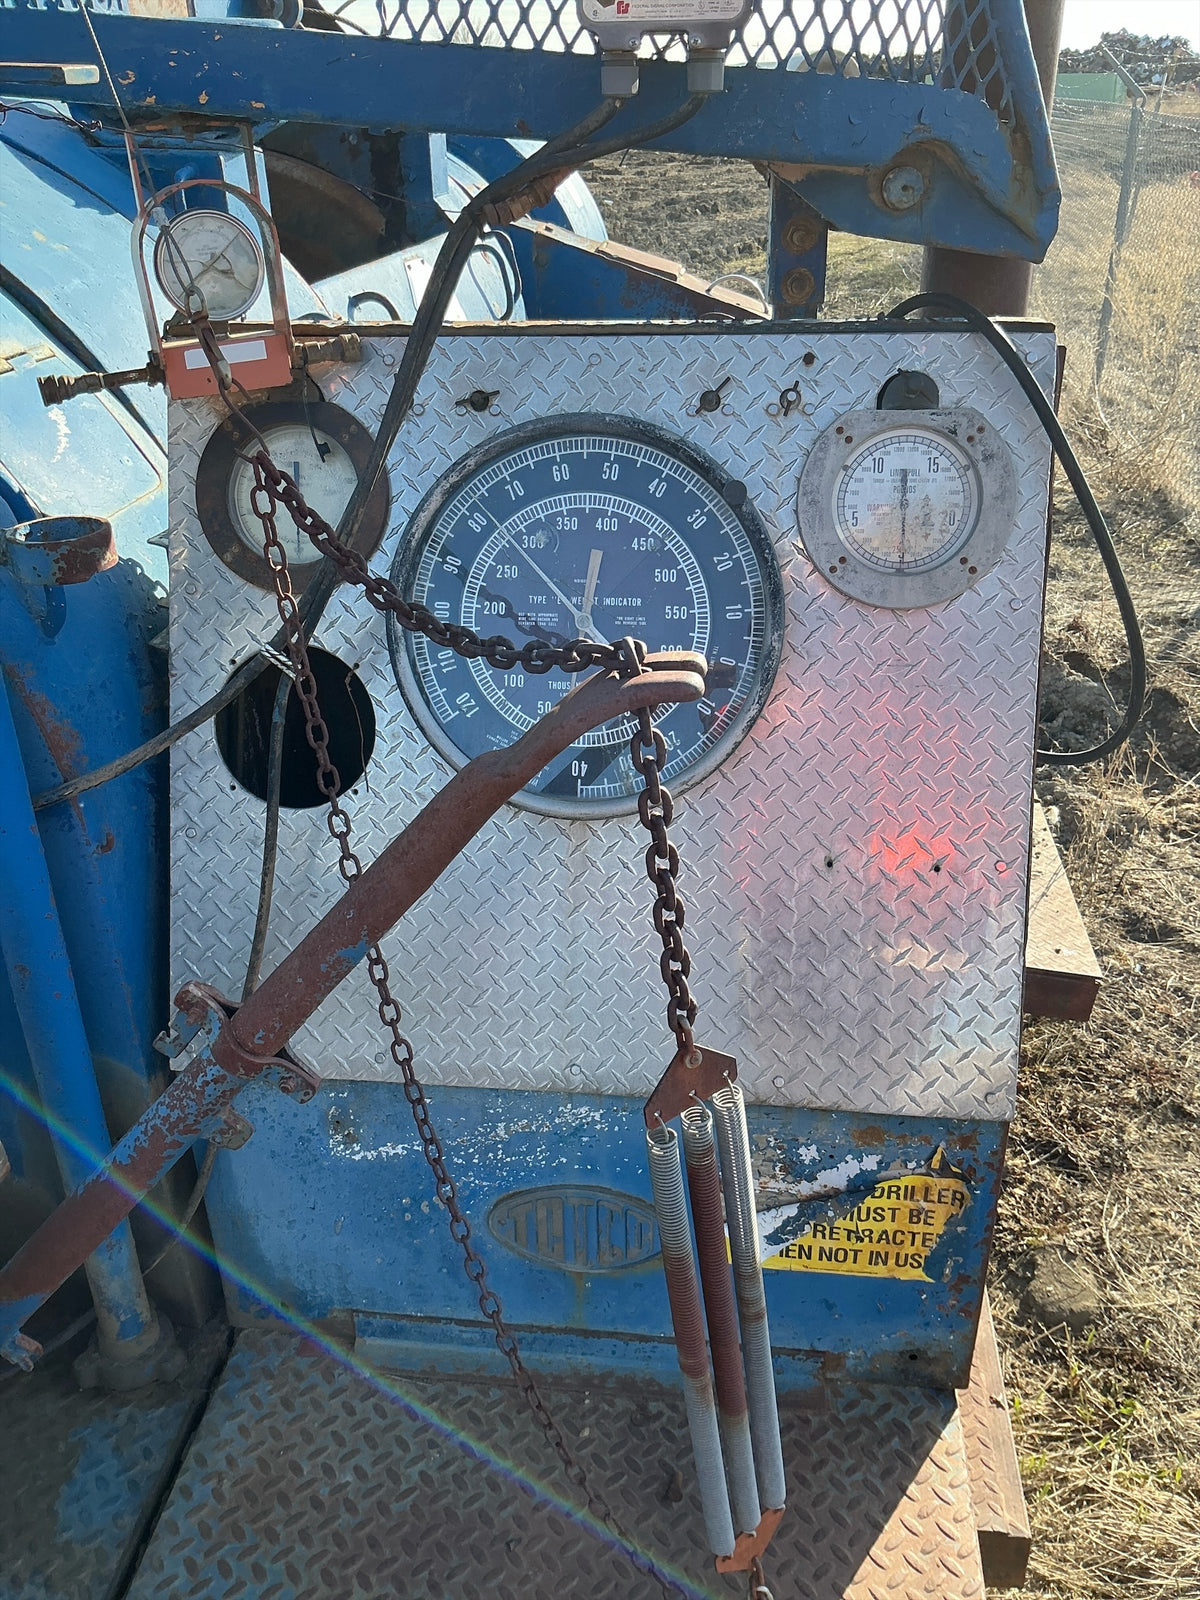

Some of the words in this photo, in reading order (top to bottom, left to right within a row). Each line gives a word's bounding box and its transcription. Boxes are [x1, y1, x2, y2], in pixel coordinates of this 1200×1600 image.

[553, 463, 570, 481] 60
[602, 463, 619, 481] 50
[872, 457, 884, 473] 10
[927, 456, 940, 473] 15
[505, 480, 525, 500] 70
[648, 478, 667, 497] 40
[467, 512, 487, 532] 80
[556, 517, 578, 531] 350
[595, 518, 618, 531] 400
[687, 509, 707, 530] 30
[851, 511, 859, 527] 5
[522, 535, 544, 549] 300
[631, 537, 654, 551] 450
[443, 555, 462, 574] 90
[713, 552, 733, 571] 20
[496, 565, 518, 578] 250
[654, 569, 677, 583] 500
[483, 601, 506, 615] 200
[528, 595, 547, 605] TYPE
[603, 597, 642, 607] INDICATOR
[434, 601, 450, 624] 00
[665, 606, 687, 620] 550
[725, 604, 743, 620] 10
[438, 650, 457, 673] 110
[719, 656, 736, 666] 0
[503, 674, 524, 688] 100
[455, 692, 480, 718] 120
[537, 701, 552, 714] 50
[697, 697, 716, 715] 10
[571, 760, 588, 777] 40
[870, 1184, 966, 1210] DRILLER
[908, 1208, 936, 1226] BE
[812, 1222, 940, 1248] RETRACTE
[818, 1246, 863, 1265] NOT
[868, 1250, 888, 1267] IN
[894, 1250, 928, 1269] US
